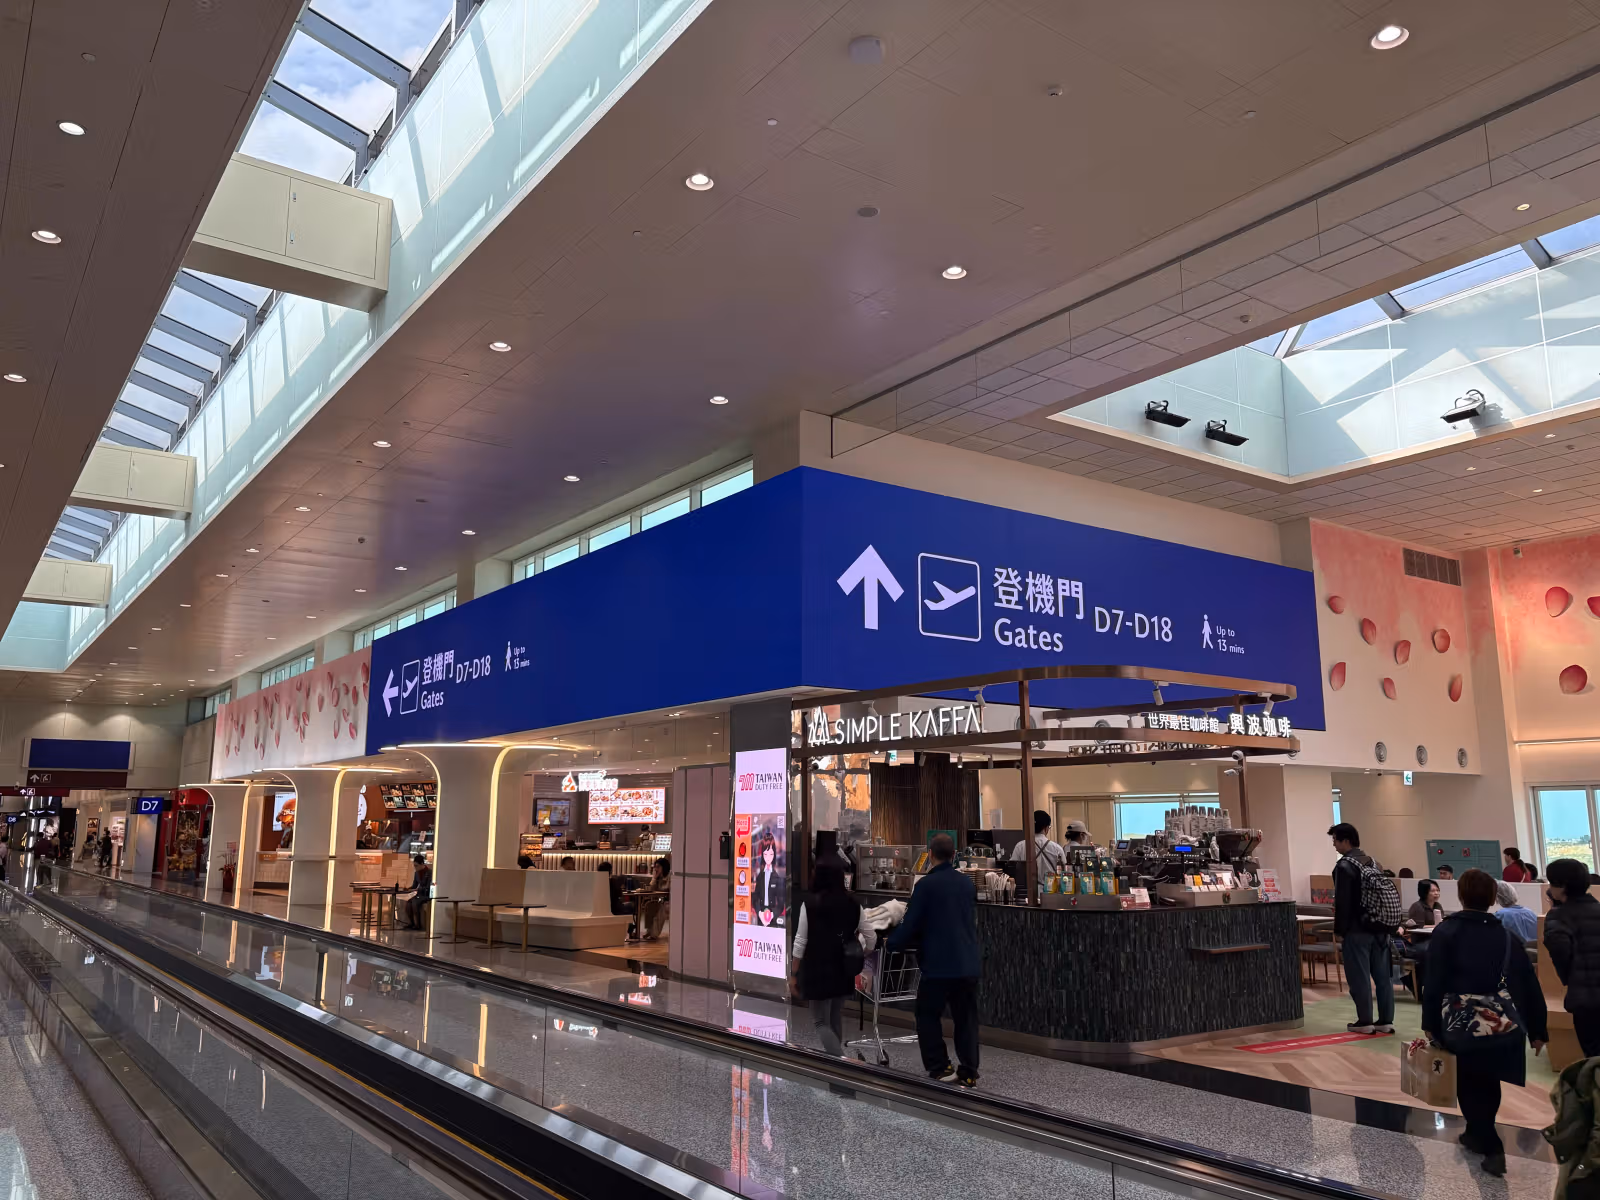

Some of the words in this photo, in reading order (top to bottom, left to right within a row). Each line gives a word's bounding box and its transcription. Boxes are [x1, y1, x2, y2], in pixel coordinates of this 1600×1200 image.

[993, 567, 1084, 620] 登機門
[1094, 606, 1173, 643] D7-D18
[1216, 625, 1226, 637] Up
[1227, 628, 1235, 638] to
[993, 617, 1064, 652] Gates
[1217, 638, 1227, 652] 13
[1229, 644, 1245, 654] mins
[421, 650, 454, 685] 登機門
[456, 655, 491, 684] D7-D18
[420, 691, 444, 710] Gates
[834, 713, 902, 745] SIMPLE
[909, 703, 982, 739] KAFFA
[1147, 712, 1219, 733] 世界最佳咖啡館
[1229, 713, 1292, 738] 興波咖啡
[755, 772, 783, 784] TAIWAN
[755, 783, 768, 791] DUTY
[769, 782, 783, 790] FREE
[141, 800, 159, 811] D7
[753, 952, 767, 961] DUTY
[768, 954, 782, 963] FREE
[754, 941, 783, 955] TAIWAN
